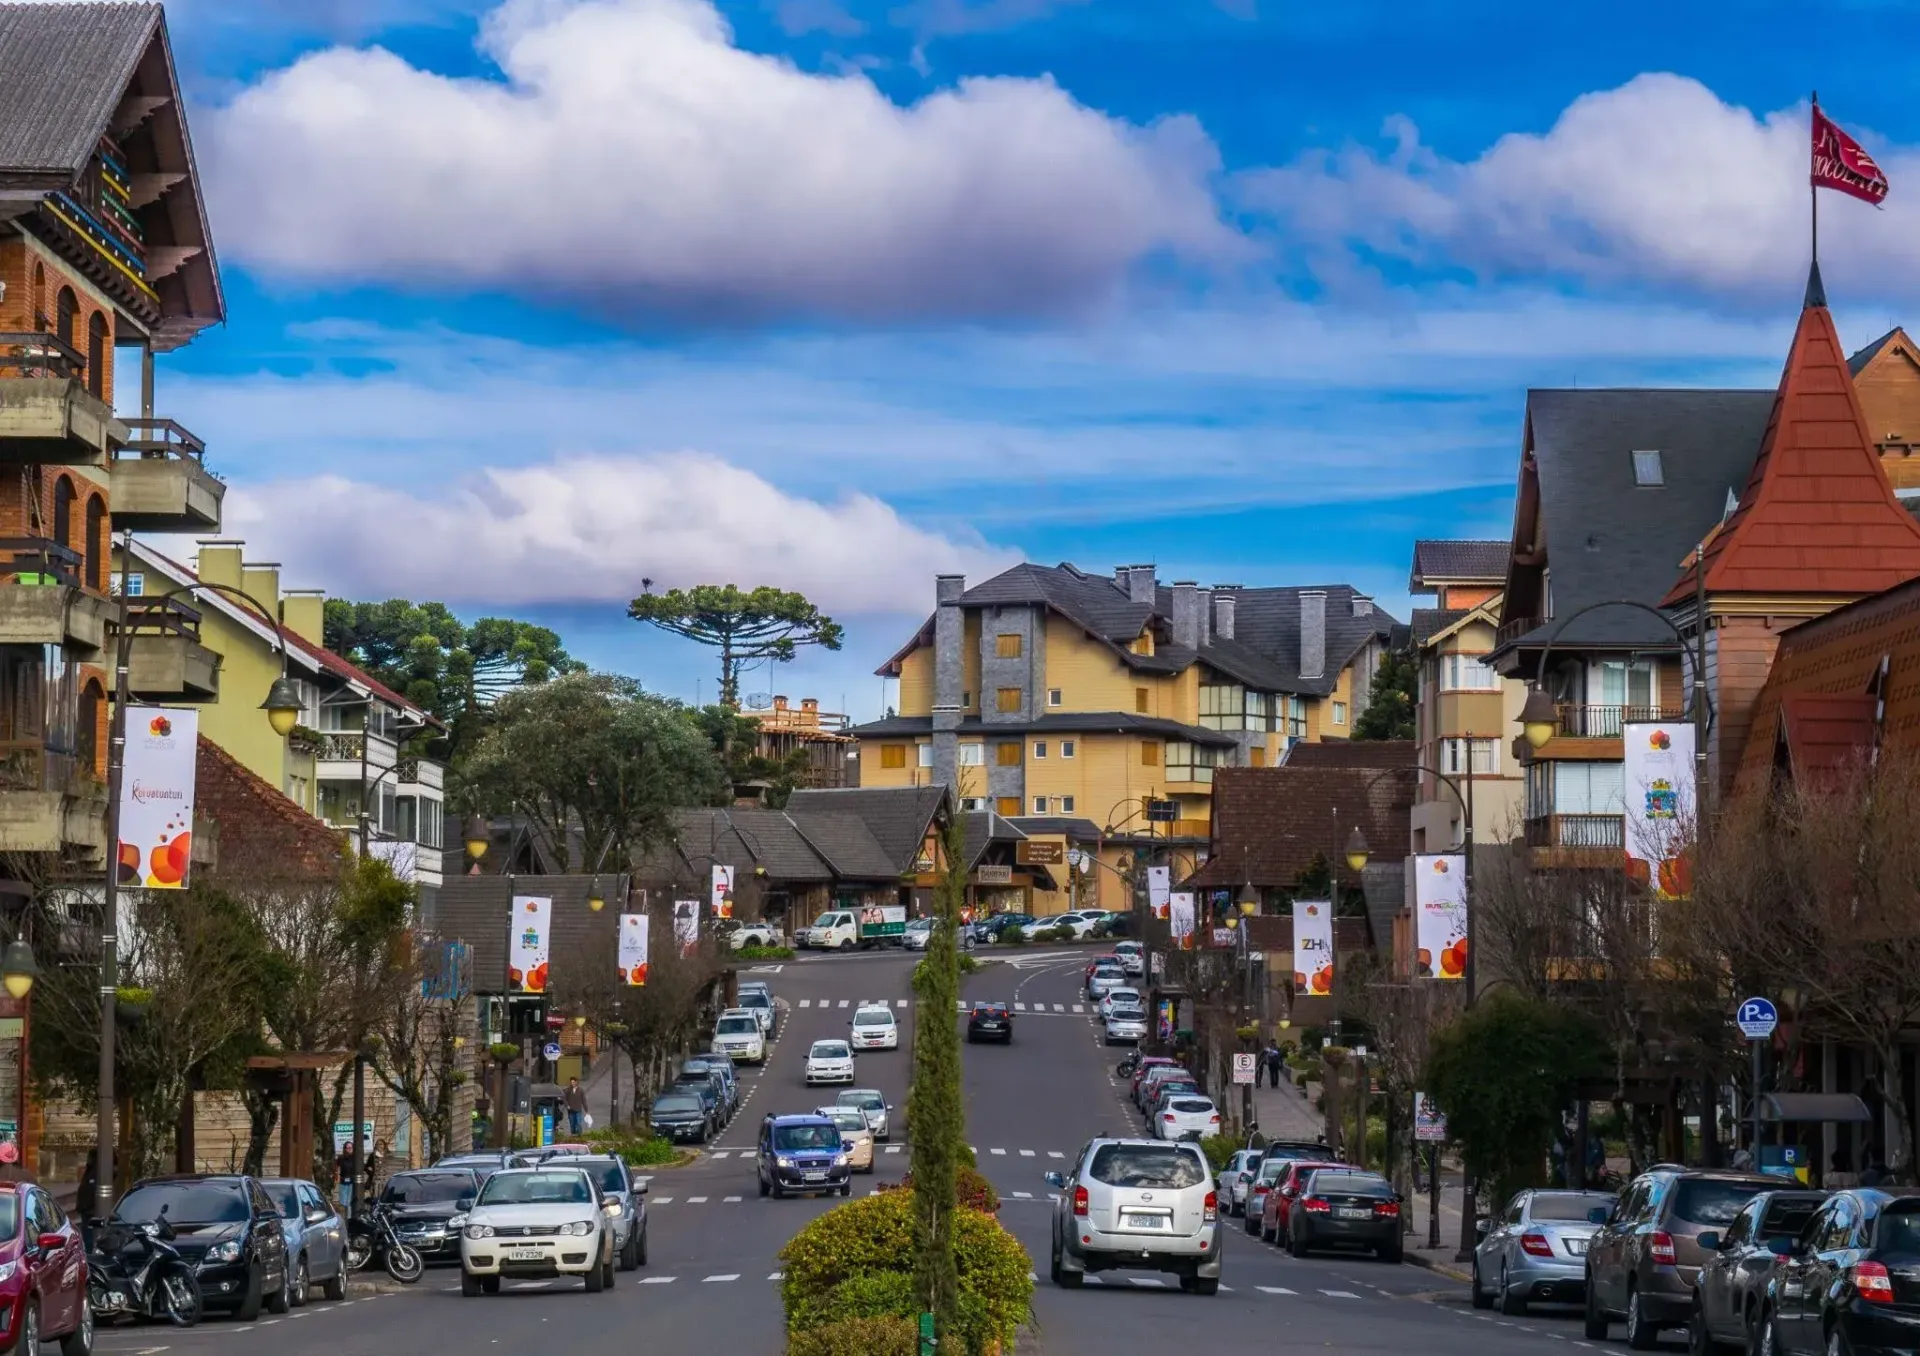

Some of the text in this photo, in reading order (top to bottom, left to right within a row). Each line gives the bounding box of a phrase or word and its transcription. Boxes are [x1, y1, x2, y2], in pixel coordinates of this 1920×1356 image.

[1302, 938, 1322, 950] ZH
[1745, 1004, 1760, 1021] P
[546, 1045, 554, 1053] P
[1241, 1056, 1248, 1067] E
